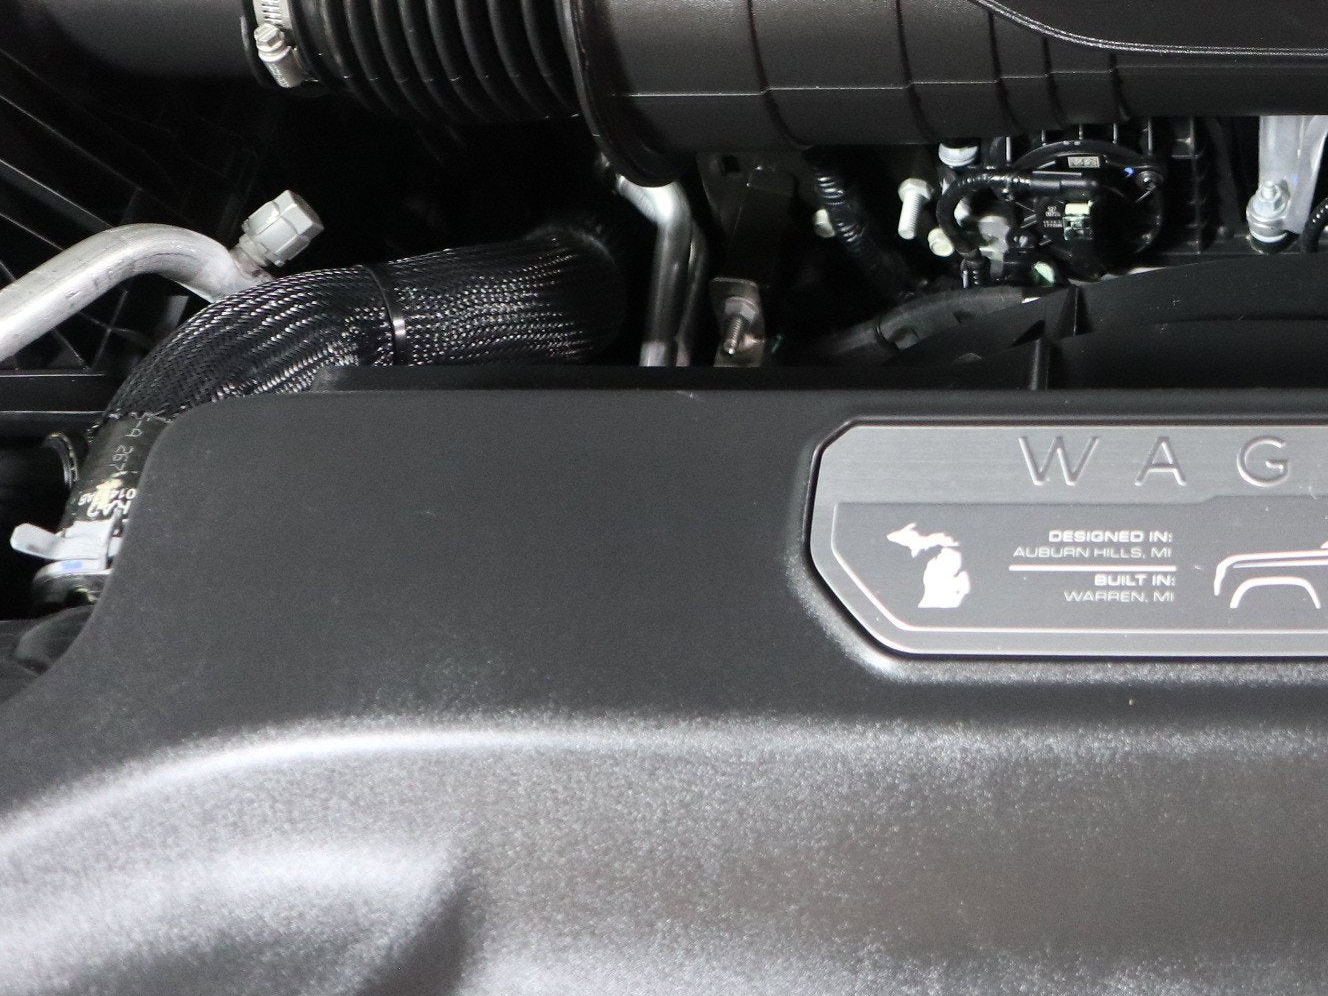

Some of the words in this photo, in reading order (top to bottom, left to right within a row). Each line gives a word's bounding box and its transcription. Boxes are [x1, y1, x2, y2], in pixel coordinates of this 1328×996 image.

[1048, 530, 1144, 543] DESIGNED
[1148, 530, 1173, 543] IN:
[1013, 547, 1090, 559] AUBURN
[1093, 547, 1145, 561] HILLS,
[1150, 547, 1172, 559] MI
[1094, 574, 1146, 587] BUILT
[1149, 574, 1175, 587] IN:
[1063, 590, 1150, 604] WARREN,
[1153, 591, 1174, 603] MI
